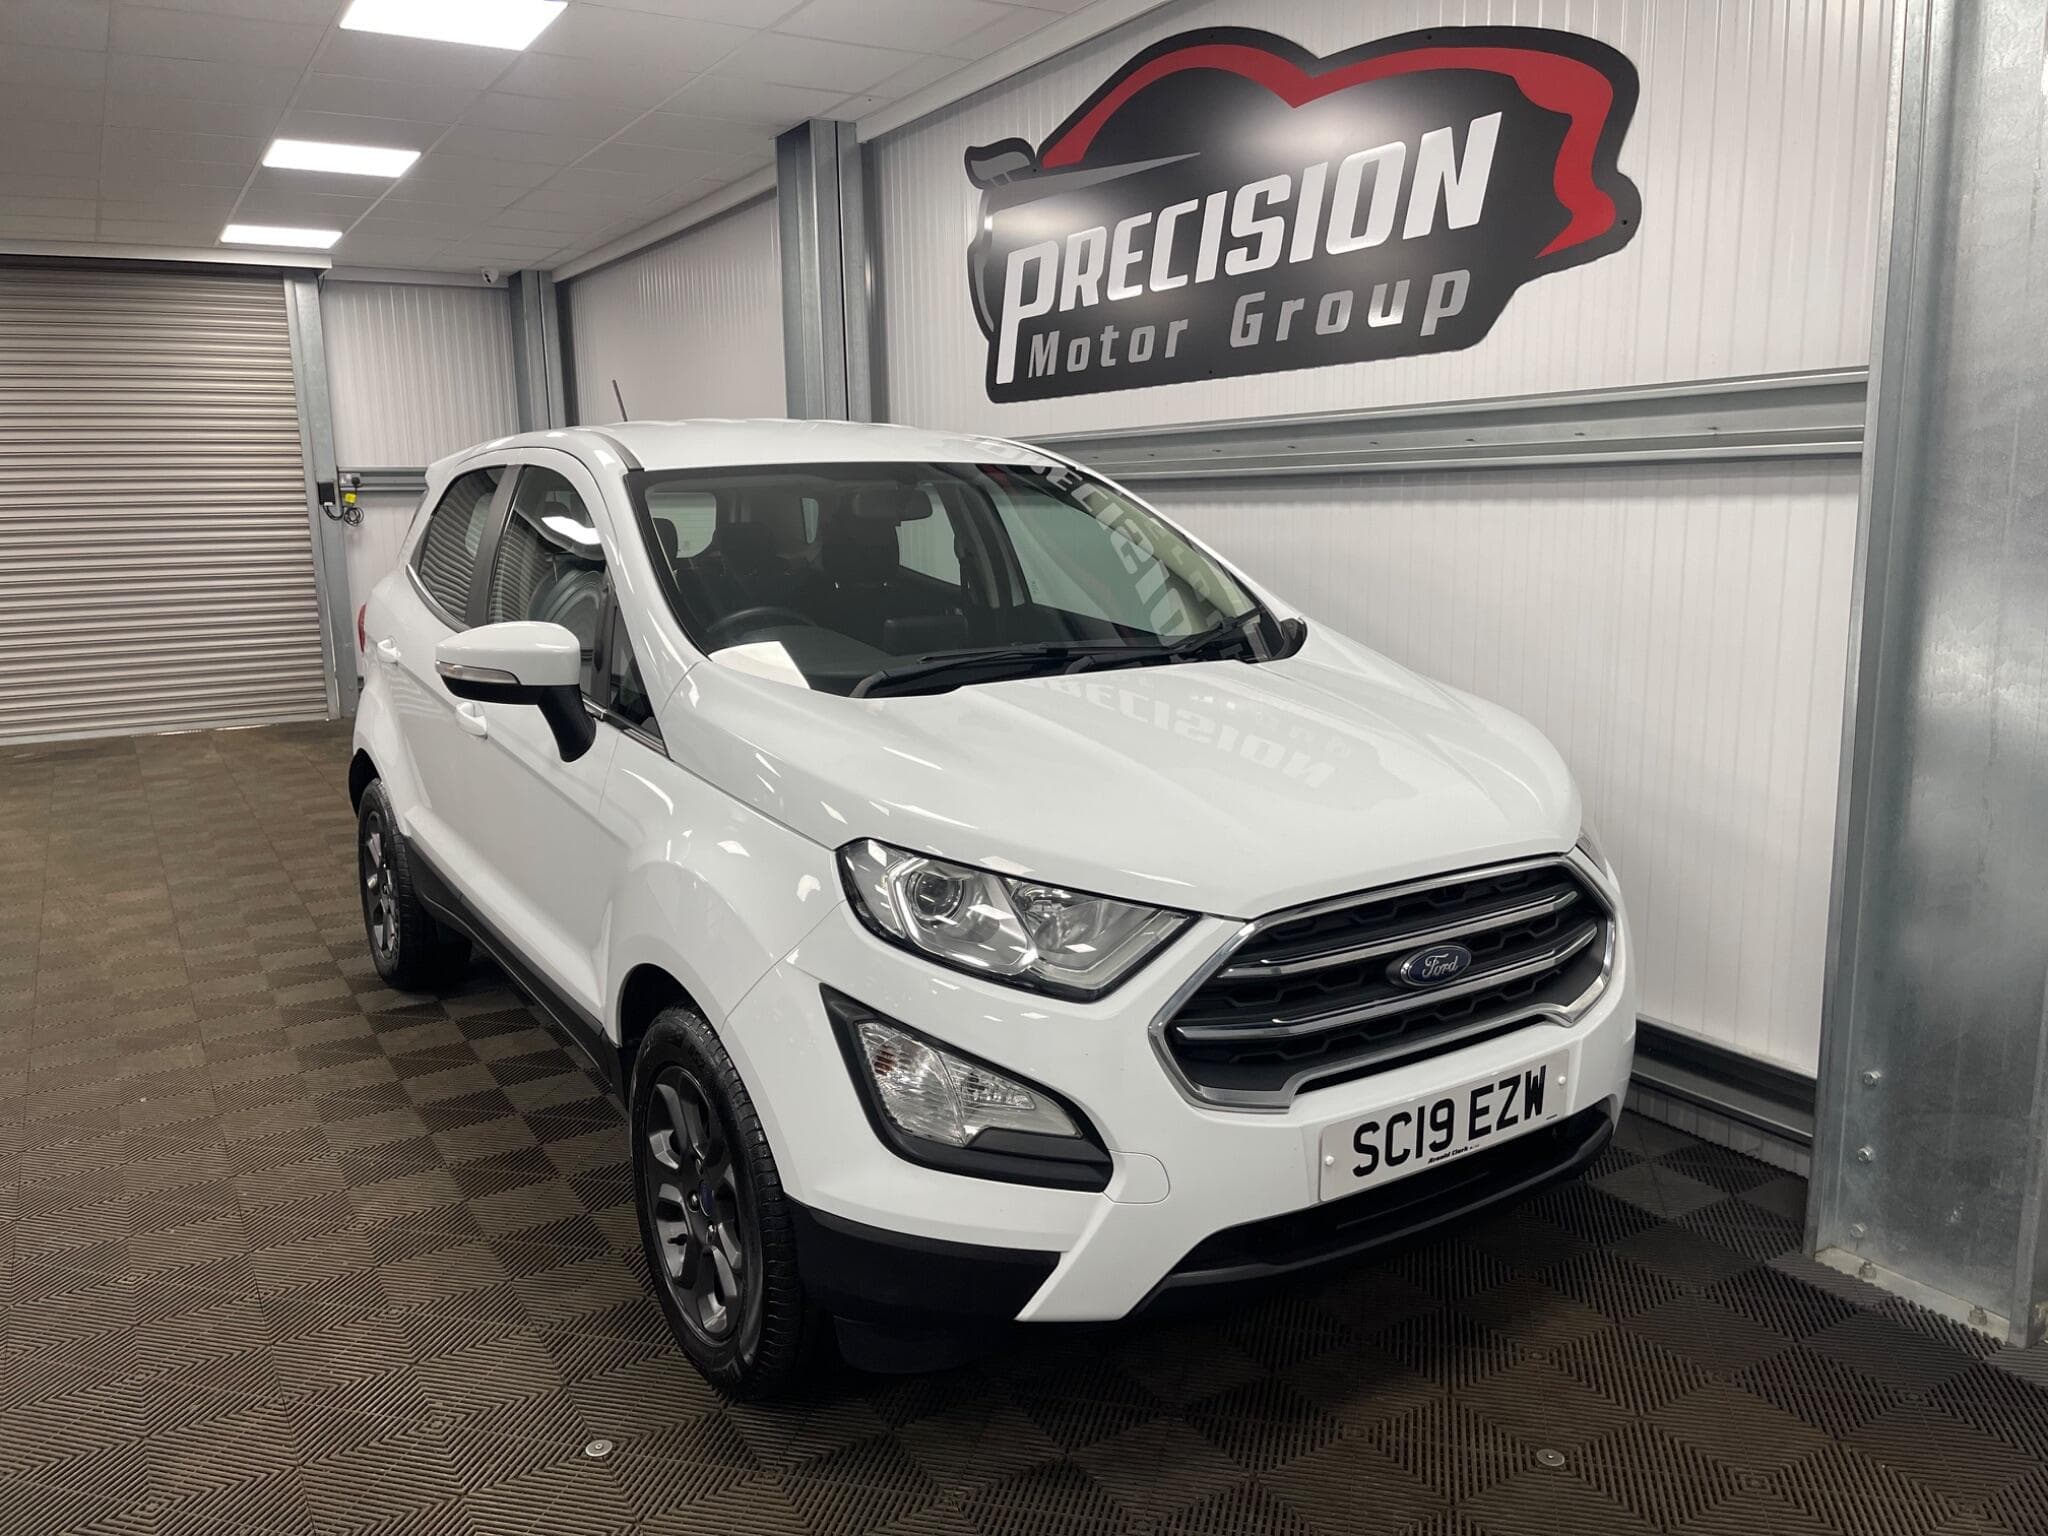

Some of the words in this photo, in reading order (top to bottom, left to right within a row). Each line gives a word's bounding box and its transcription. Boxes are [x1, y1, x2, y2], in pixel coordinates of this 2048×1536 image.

[996, 111, 1502, 384] PRECISION
[1028, 319, 1189, 378] Motor
[1230, 270, 1471, 349] Group
[1422, 953, 1459, 978] Ford
[1353, 1098, 1455, 1177] SC19
[1469, 1065, 1547, 1141] EZW
